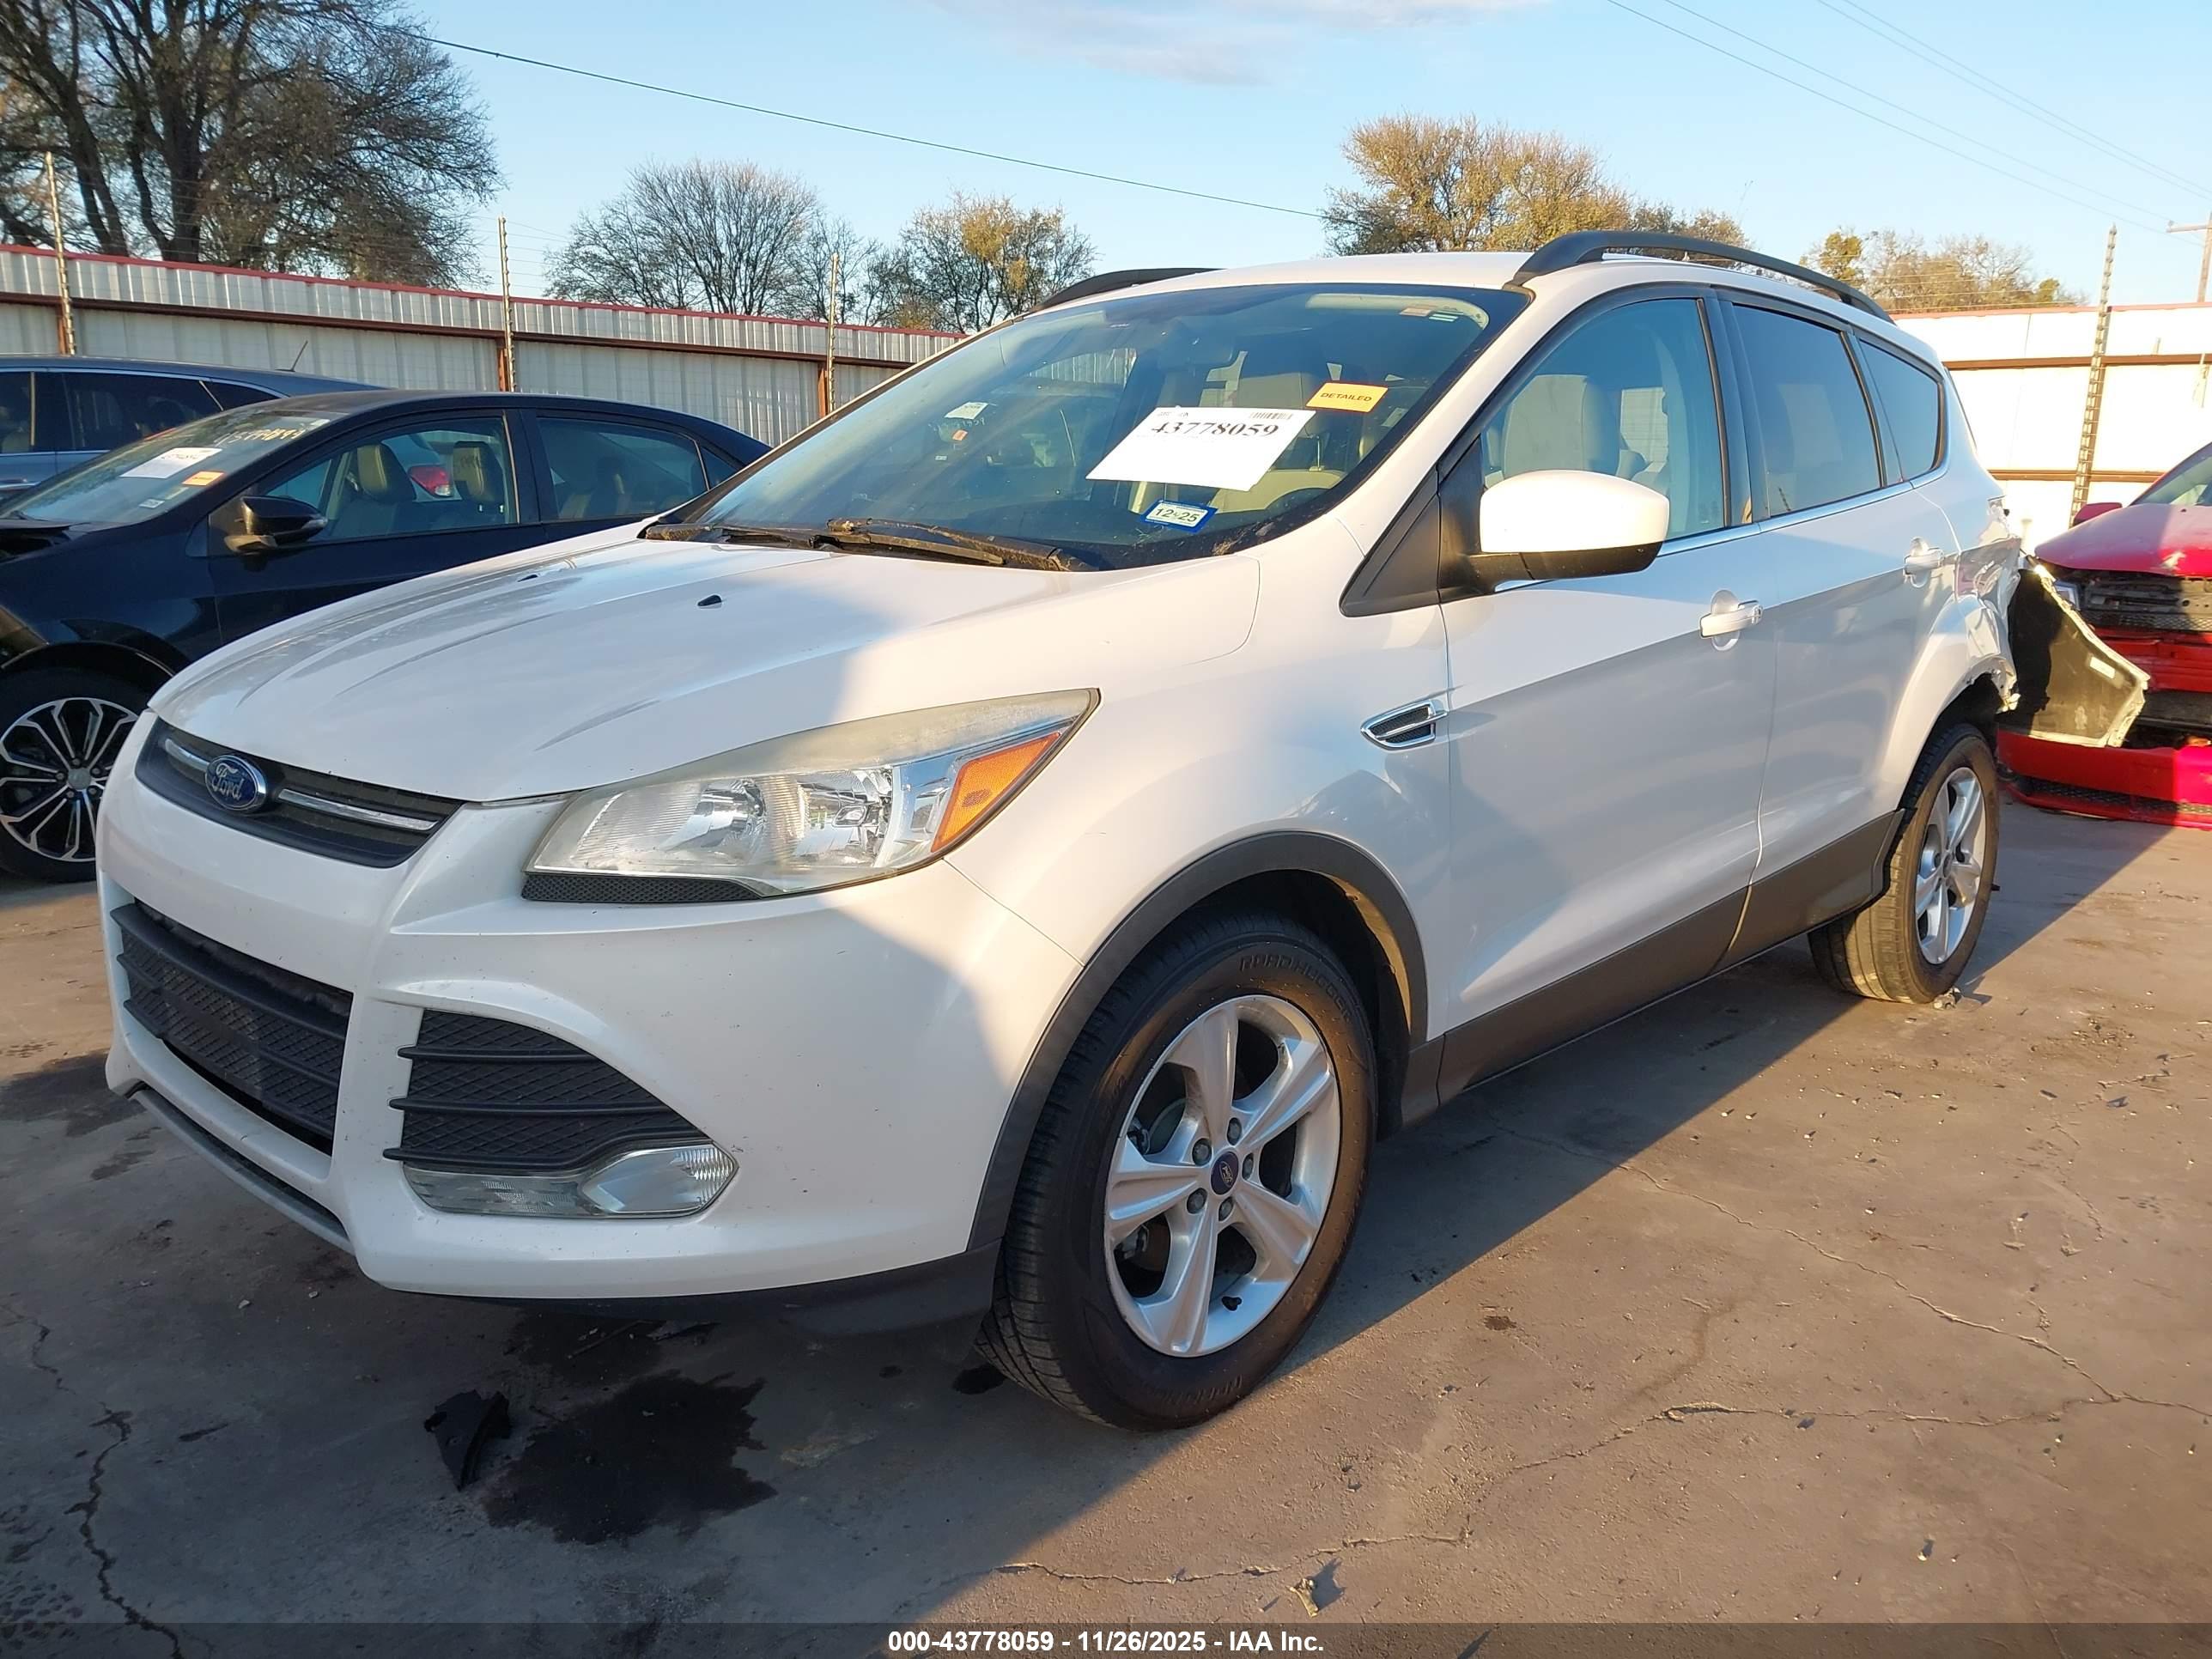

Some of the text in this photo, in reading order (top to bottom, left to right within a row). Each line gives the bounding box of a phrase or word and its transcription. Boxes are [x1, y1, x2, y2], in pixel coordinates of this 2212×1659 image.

[1320, 392, 1372, 402] DETAILED
[1151, 422, 1279, 436] 43778059
[1155, 507, 1175, 518] 12
[1177, 511, 1200, 522] 25
[211, 763, 245, 800] Ford
